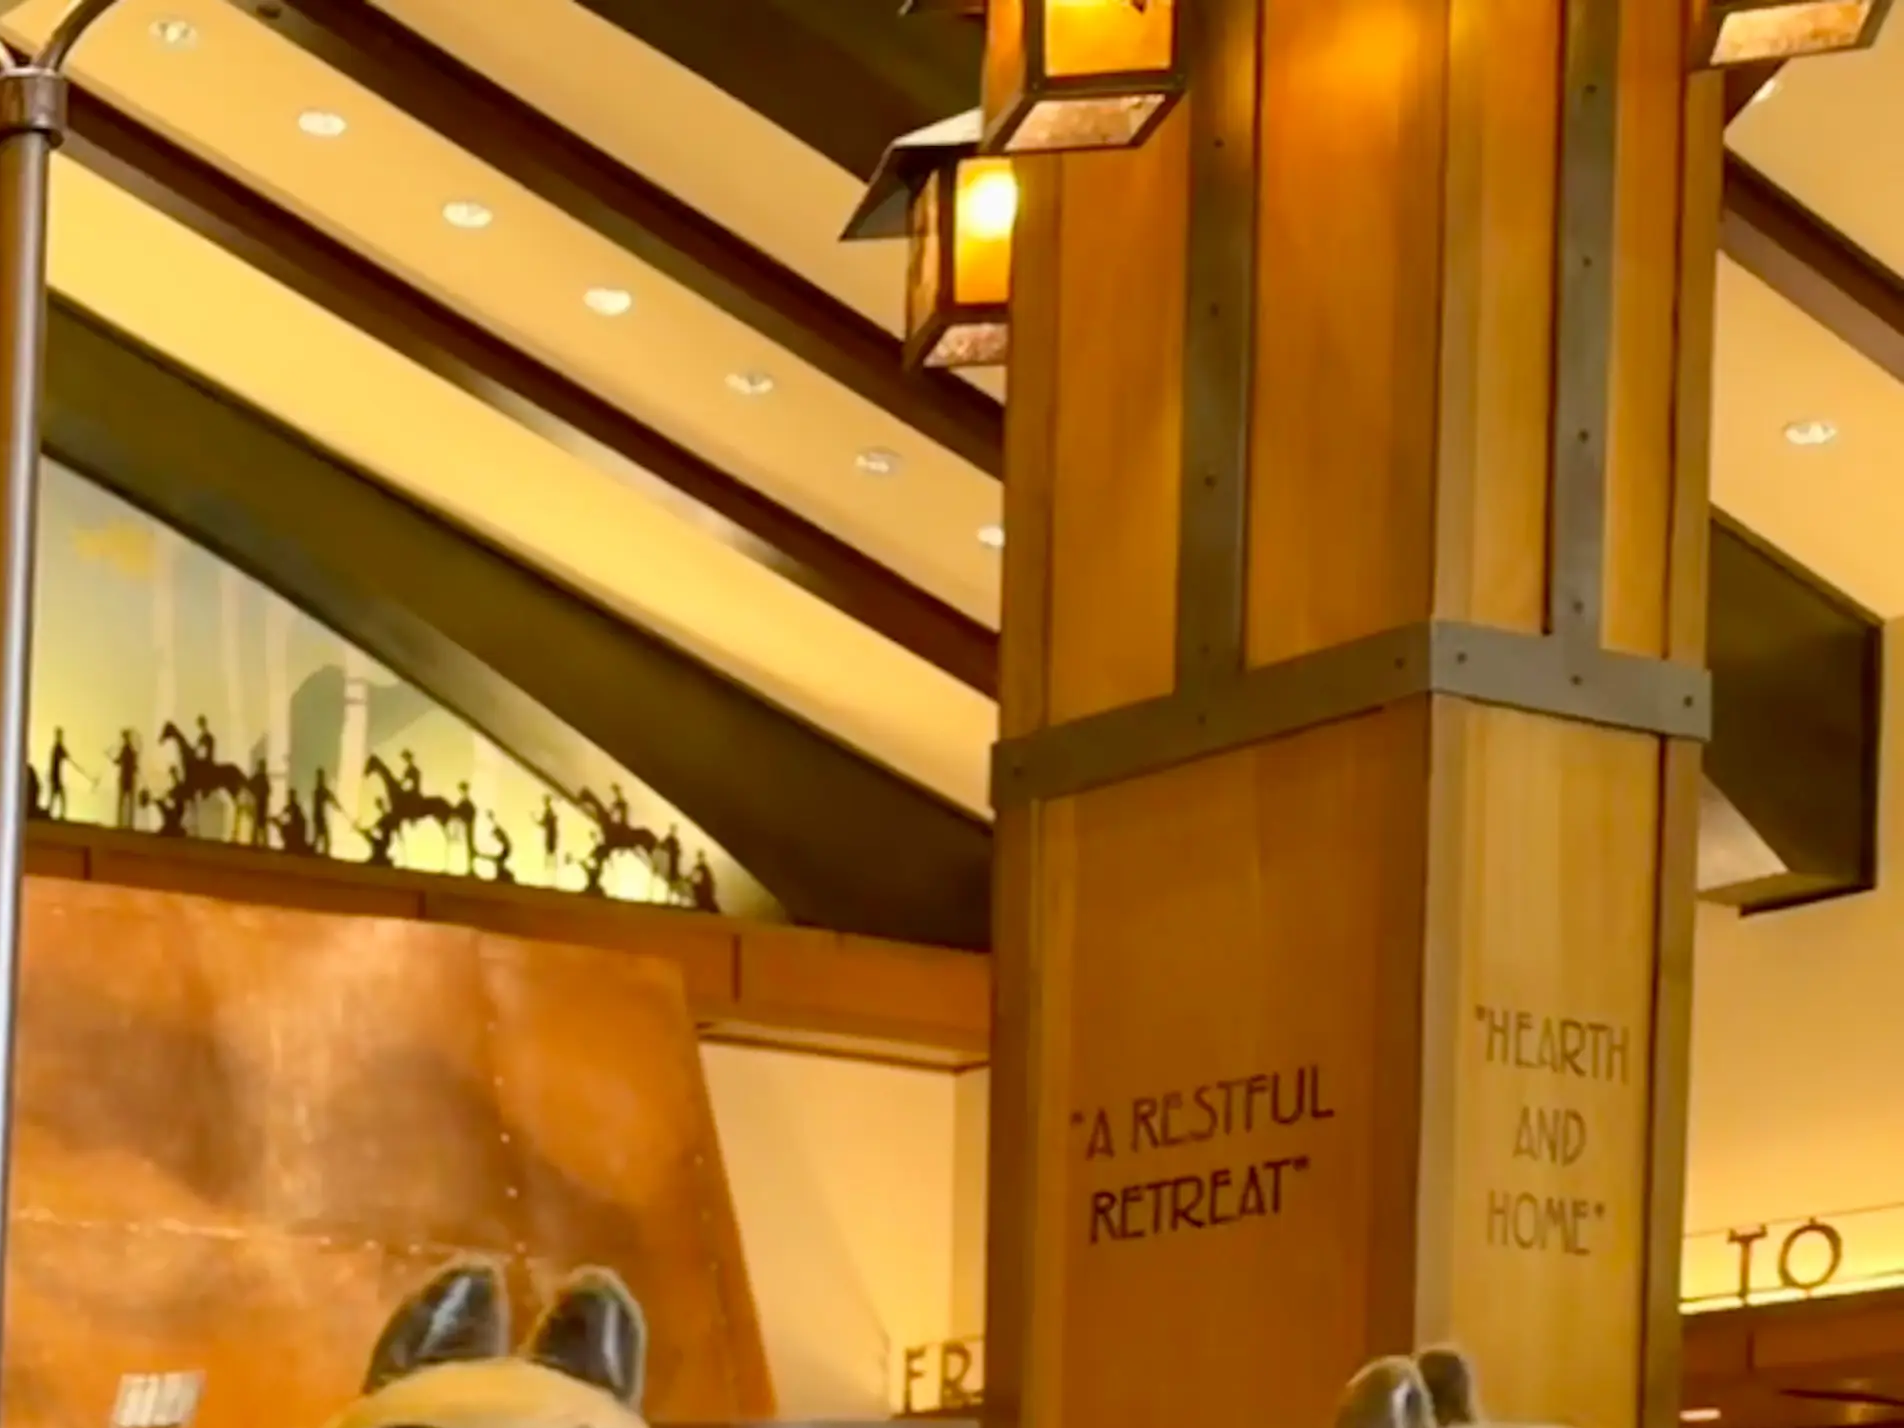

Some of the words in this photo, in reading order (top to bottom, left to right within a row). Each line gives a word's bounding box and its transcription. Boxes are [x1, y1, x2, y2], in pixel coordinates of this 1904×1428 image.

[1475, 1004, 1629, 1086] "HEARTH
[1130, 1063, 1335, 1153] RESTFUL
[1512, 1106, 1586, 1167] AND
[1090, 1155, 1310, 1245] RETREAT"
[1486, 1190, 1605, 1256] HOME"
[1728, 1216, 1842, 1303] TO
[903, 1341, 984, 1412] FR
